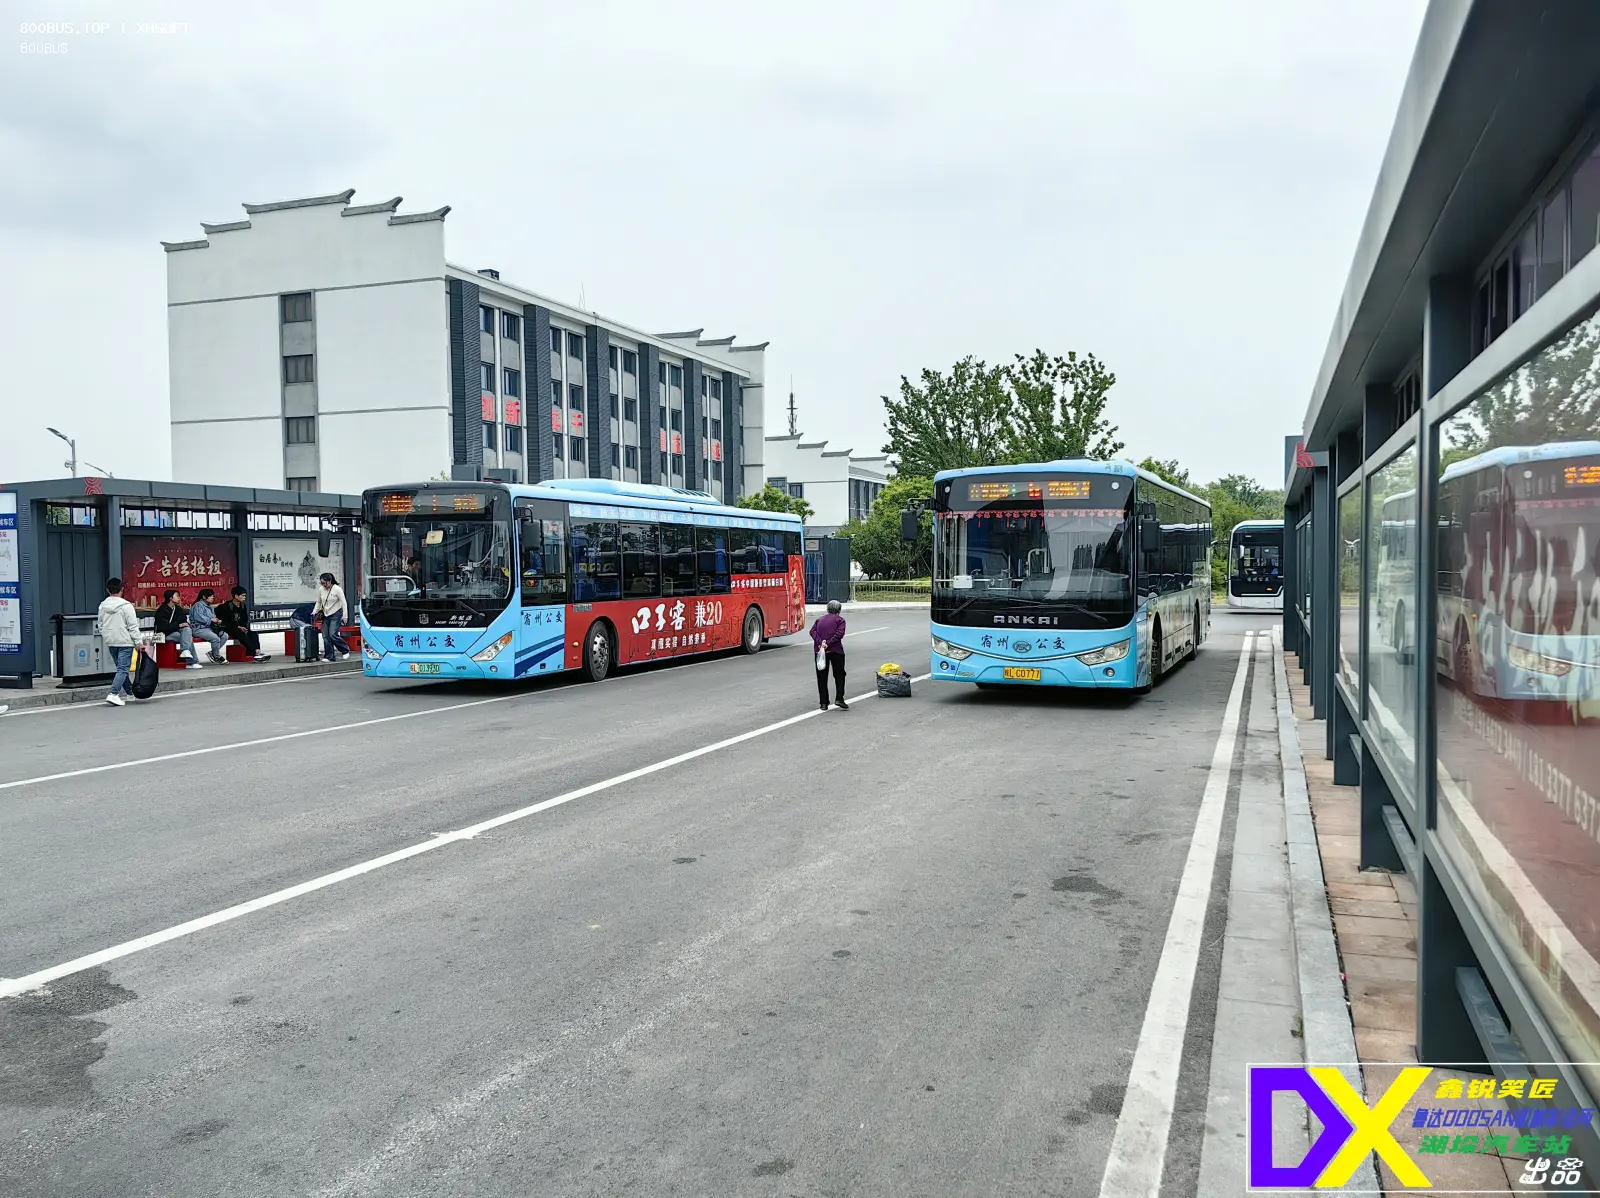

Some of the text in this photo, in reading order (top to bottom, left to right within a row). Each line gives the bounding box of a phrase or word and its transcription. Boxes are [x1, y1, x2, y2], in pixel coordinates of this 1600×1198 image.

[993, 615, 1059, 625] ANKAI
[394, 633, 456, 649] 宿州公交
